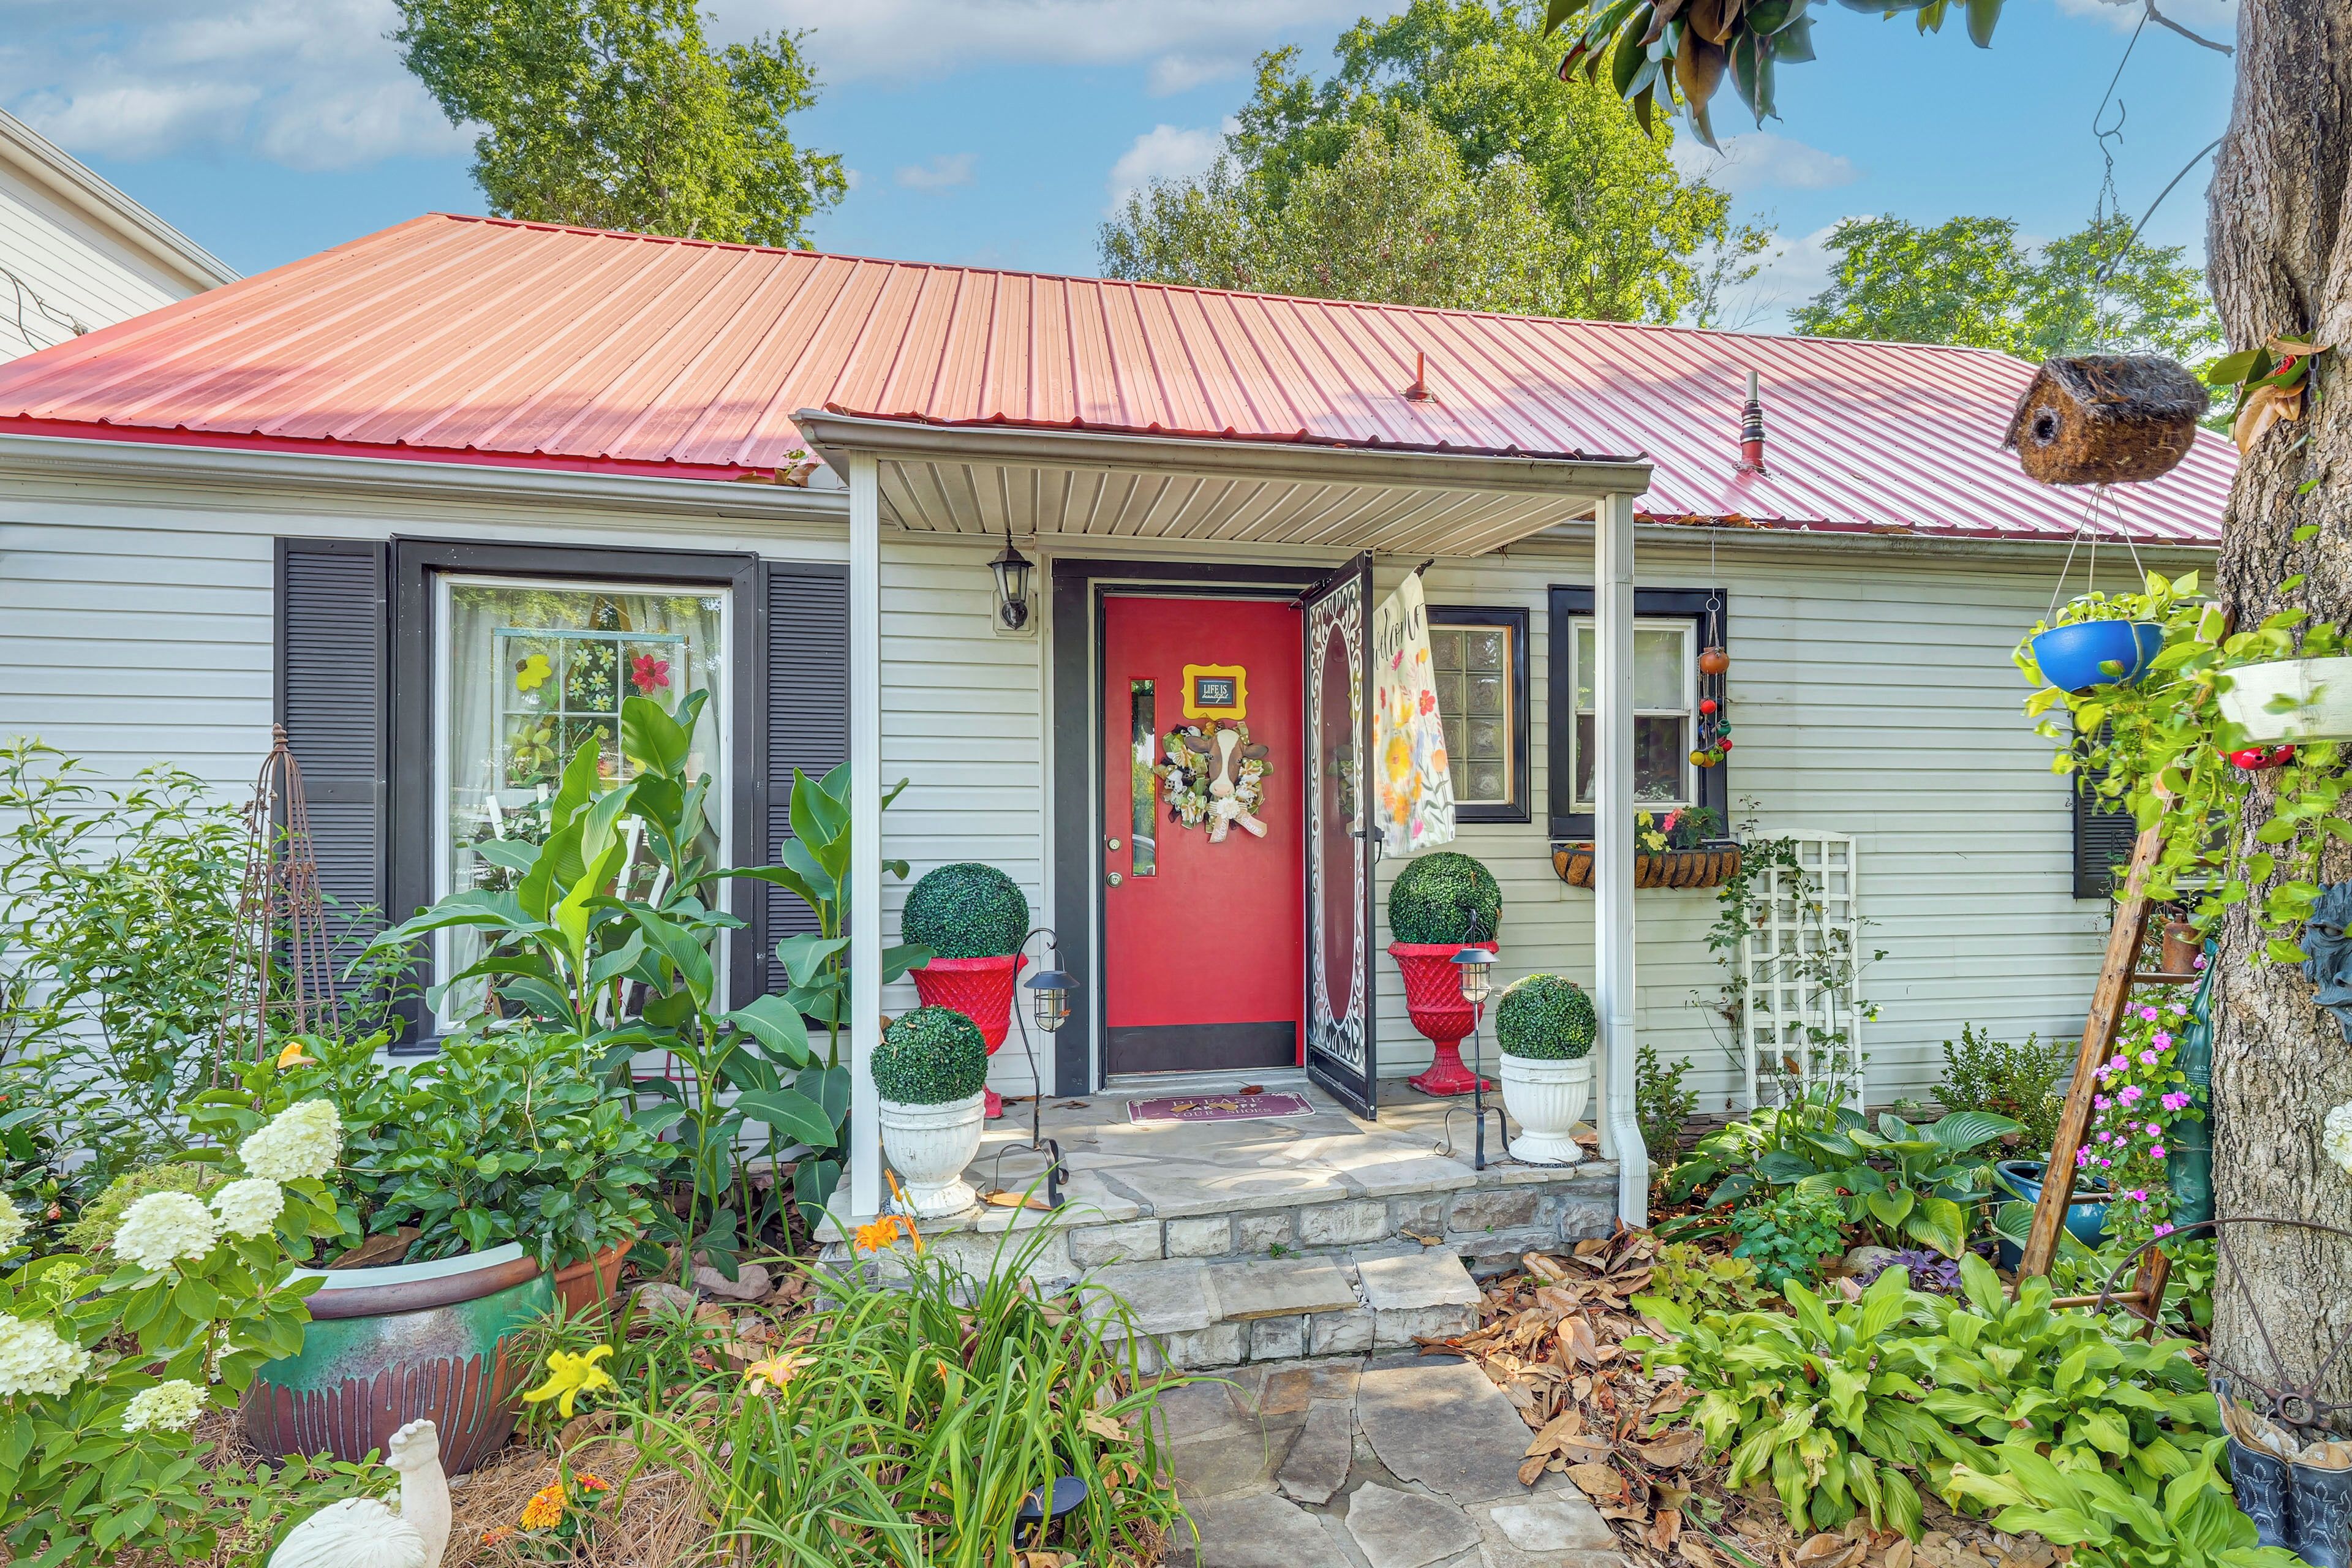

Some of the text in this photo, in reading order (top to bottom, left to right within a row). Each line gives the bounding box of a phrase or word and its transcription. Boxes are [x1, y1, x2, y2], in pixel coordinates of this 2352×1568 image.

[1204, 684, 1227, 694] LIFE IS
[1172, 1097, 1263, 1107] PLEASE
